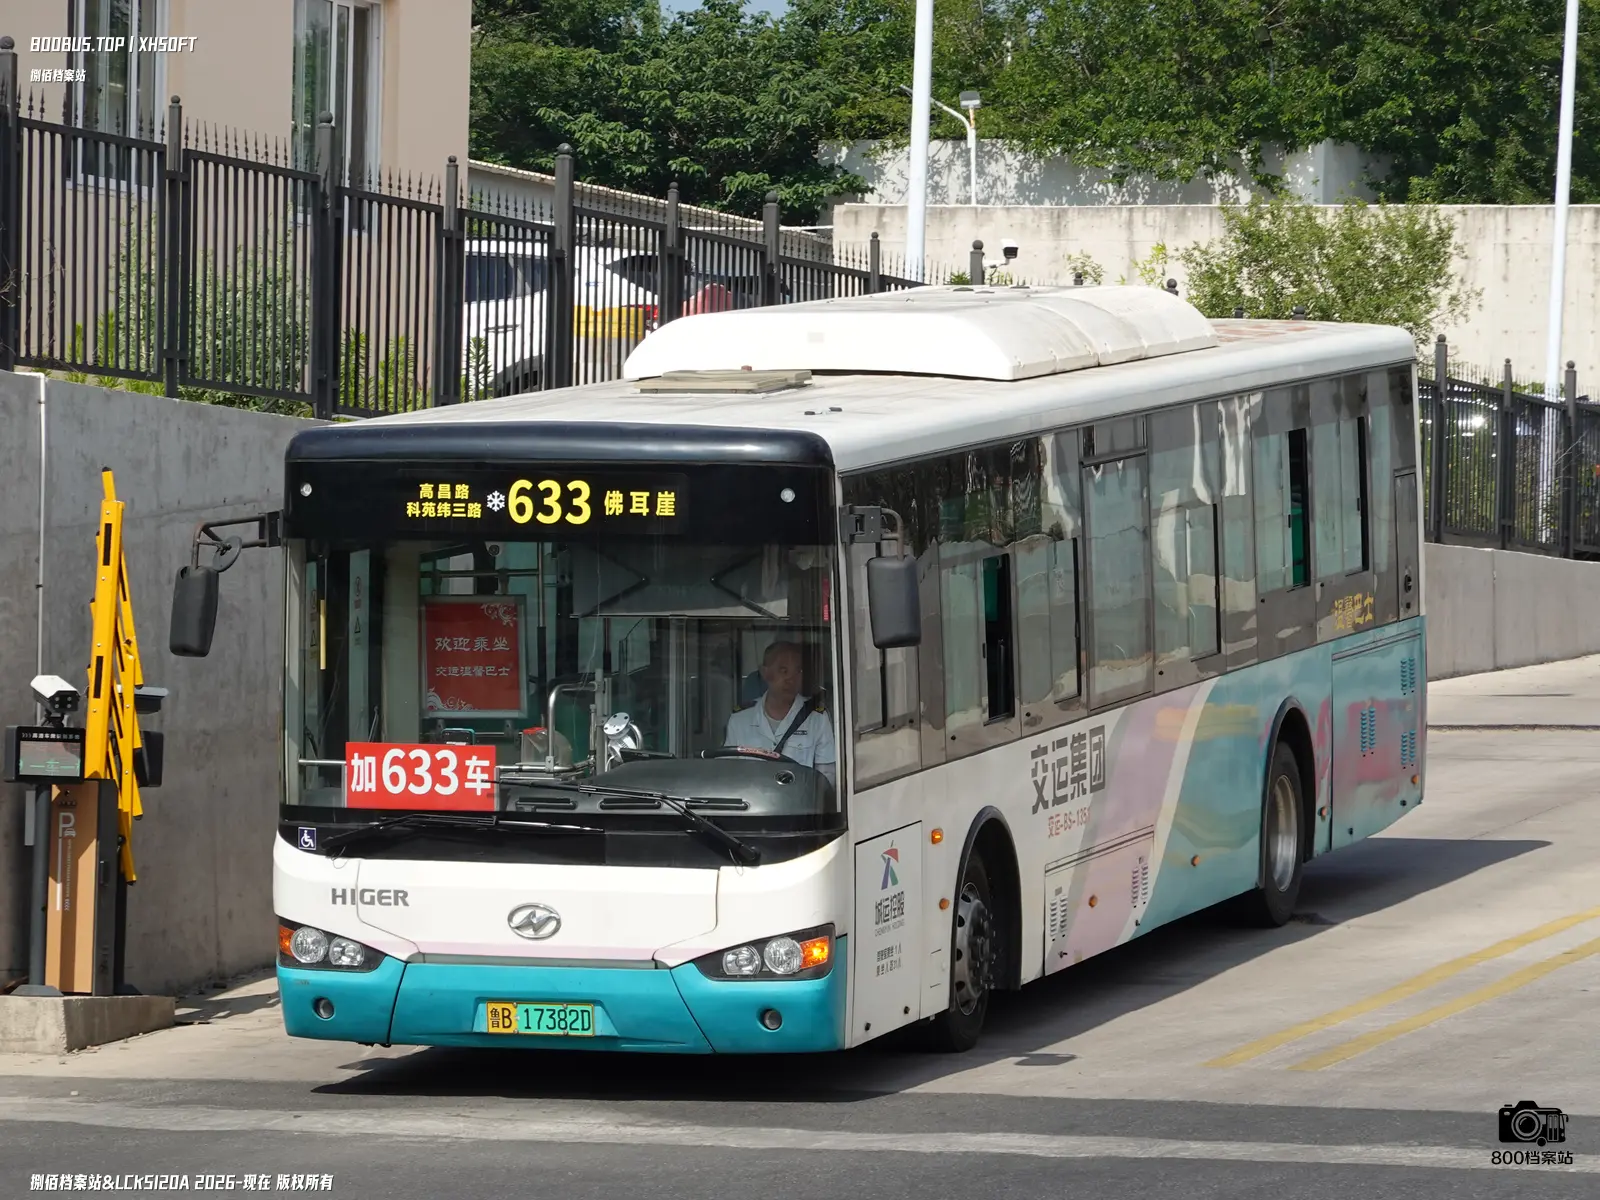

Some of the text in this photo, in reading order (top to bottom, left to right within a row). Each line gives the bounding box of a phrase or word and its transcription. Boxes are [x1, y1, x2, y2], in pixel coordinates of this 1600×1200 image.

[419, 483, 469, 499] 高昌路
[406, 502, 482, 518] 科苑纬三路
[508, 479, 591, 525] 633
[604, 490, 676, 516] 佛耳崖
[435, 637, 510, 651] 欢迎乘坐
[1030, 725, 1105, 815] 交运集团
[331, 888, 409, 906] HIGER
[490, 1007, 591, 1031] 鲁B 17382D
